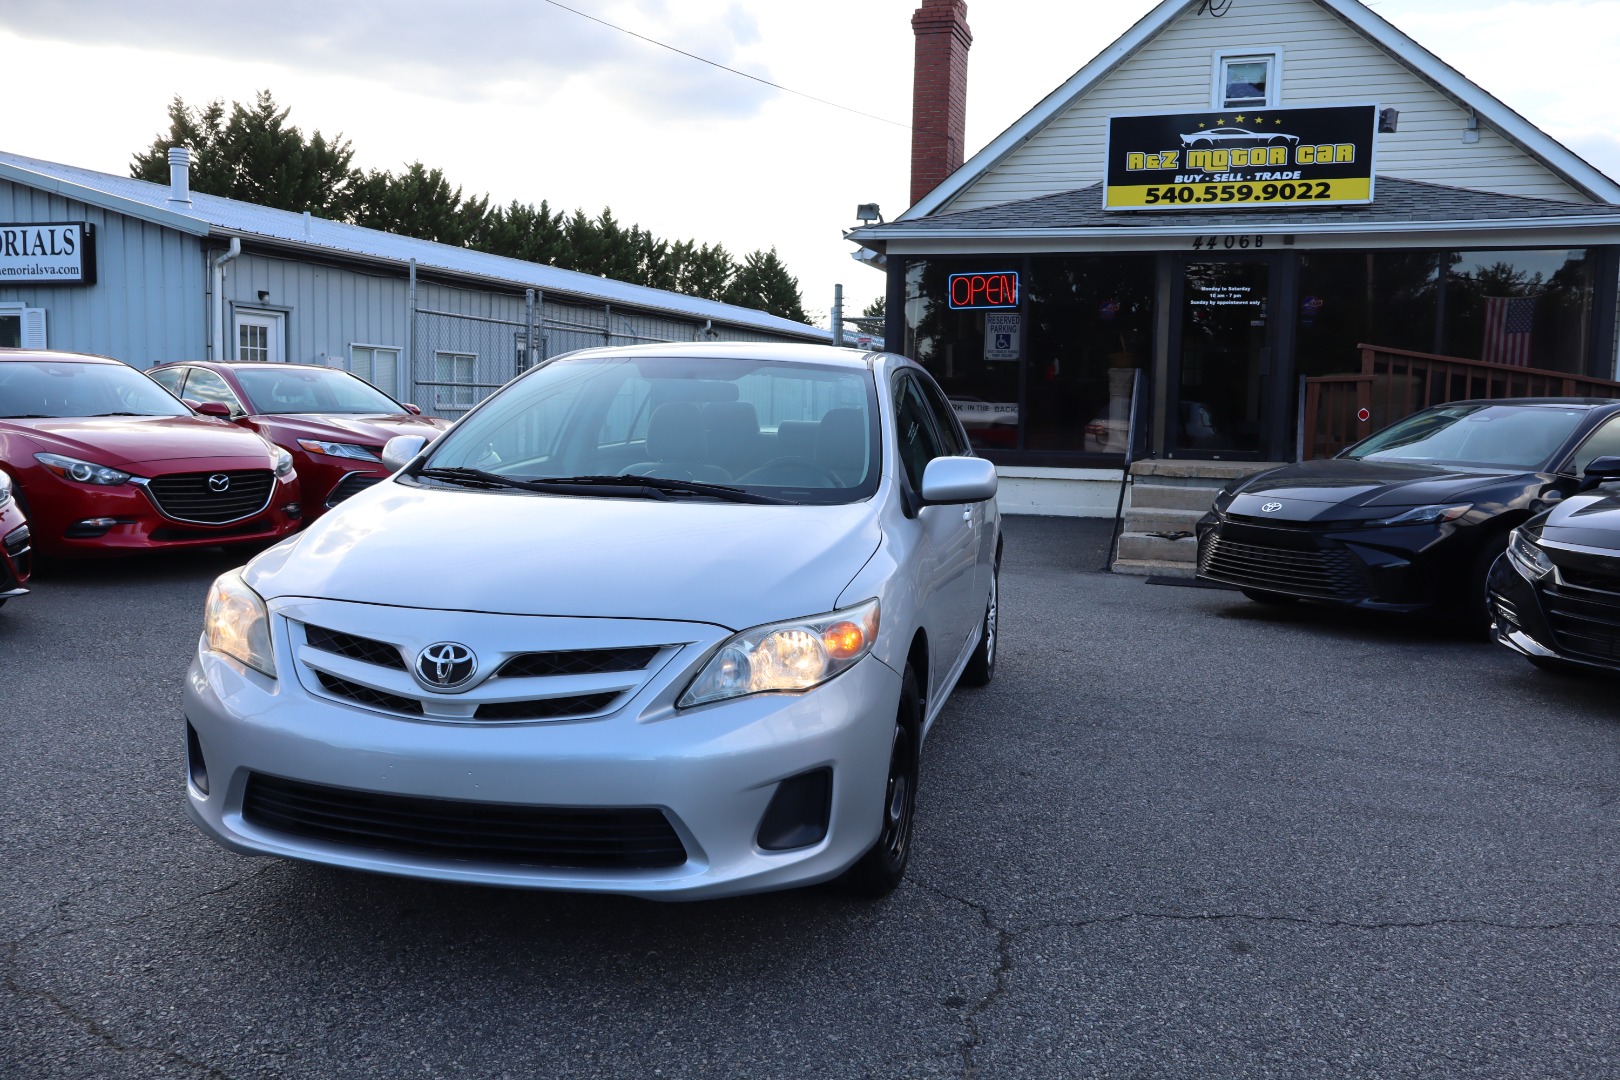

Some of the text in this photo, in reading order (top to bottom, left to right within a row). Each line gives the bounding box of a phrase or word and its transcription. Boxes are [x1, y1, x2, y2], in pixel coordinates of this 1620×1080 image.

[1126, 150, 1179, 171] A&Z
[1295, 143, 1355, 165] CAR
[1174, 171, 1302, 183] BUY SELL TRADE
[1145, 182, 1331, 204] 540.559.9022
[0, 228, 75, 256] RIALS
[0, 263, 79, 275] emorialsva.com
[952, 275, 1017, 305] OPEN
[987, 316, 1020, 325] RESERVED
[990, 325, 1017, 333] PARKING
